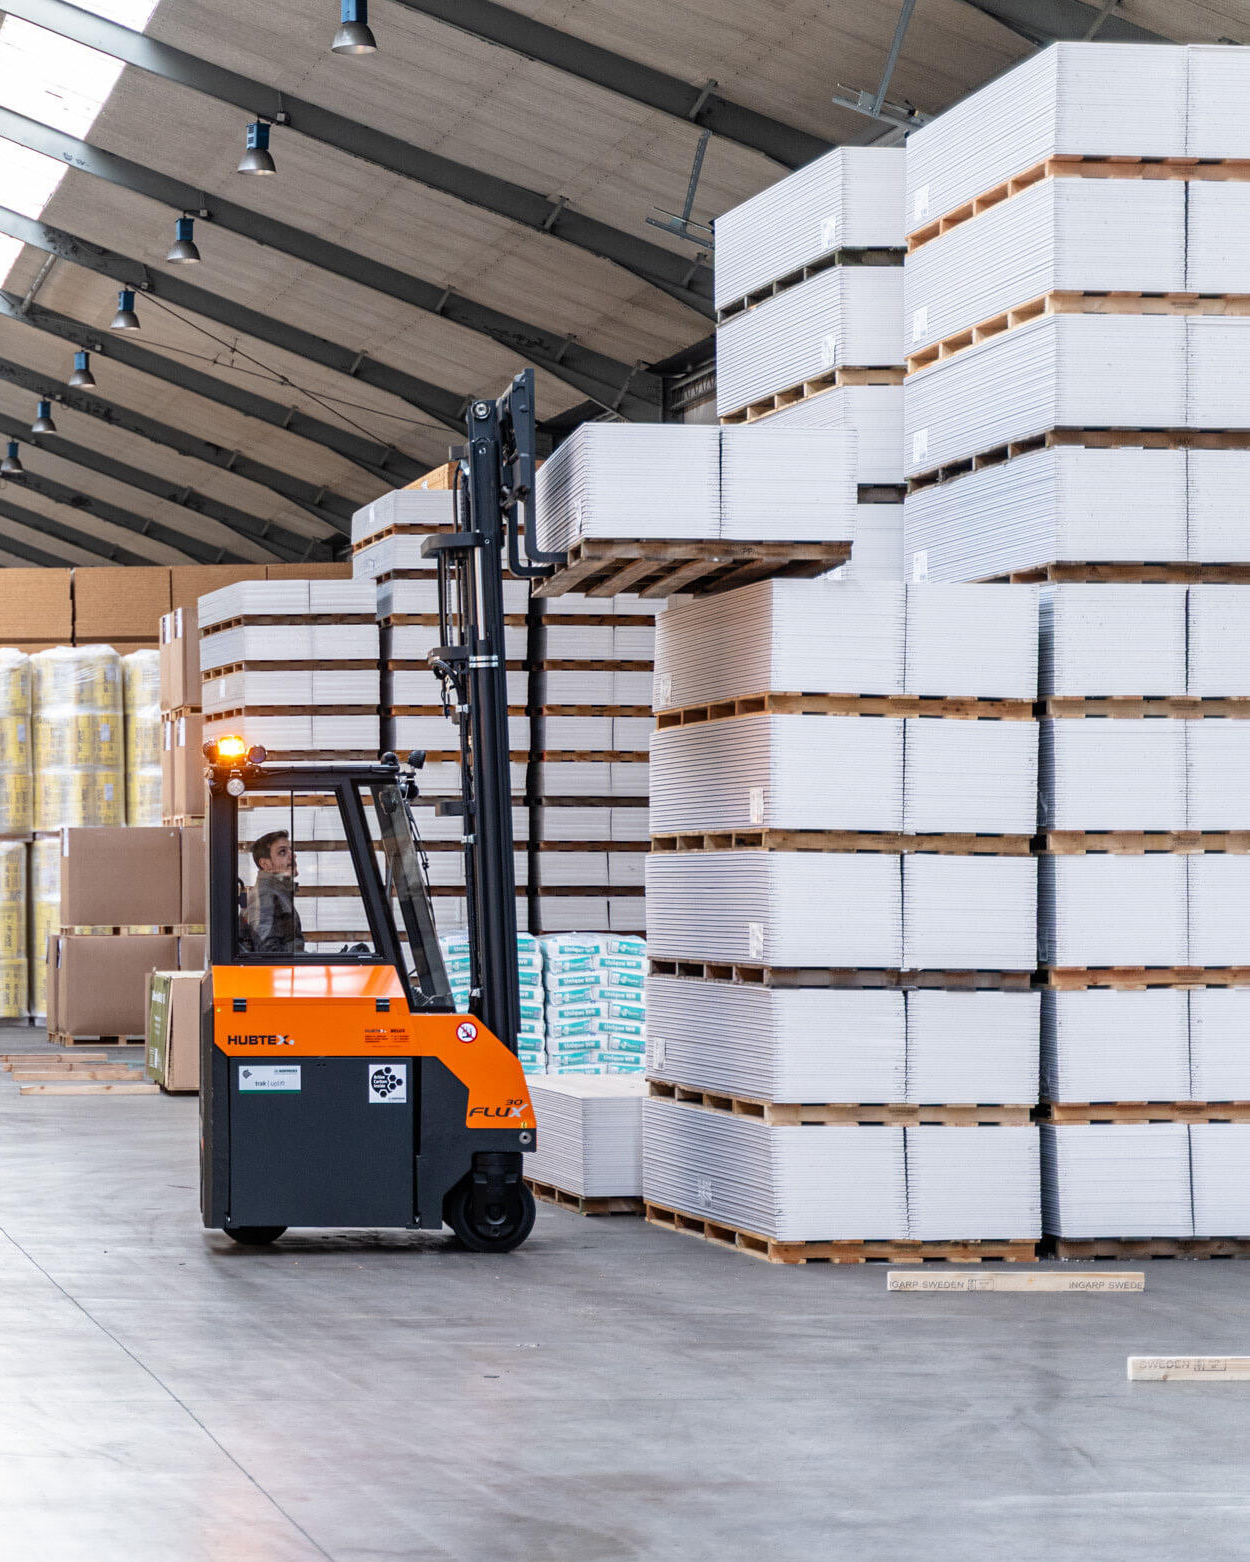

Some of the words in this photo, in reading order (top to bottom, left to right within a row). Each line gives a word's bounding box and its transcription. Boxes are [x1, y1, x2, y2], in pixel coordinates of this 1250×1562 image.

[469, 1104, 529, 1118] FLUX
[890, 1280, 919, 1289] GARP
[922, 1280, 964, 1289] SWEDEN
[1069, 1281, 1104, 1289] INGARP
[1109, 1281, 1143, 1289] SWEDE
[1140, 1359, 1190, 1369] SWEDEN
